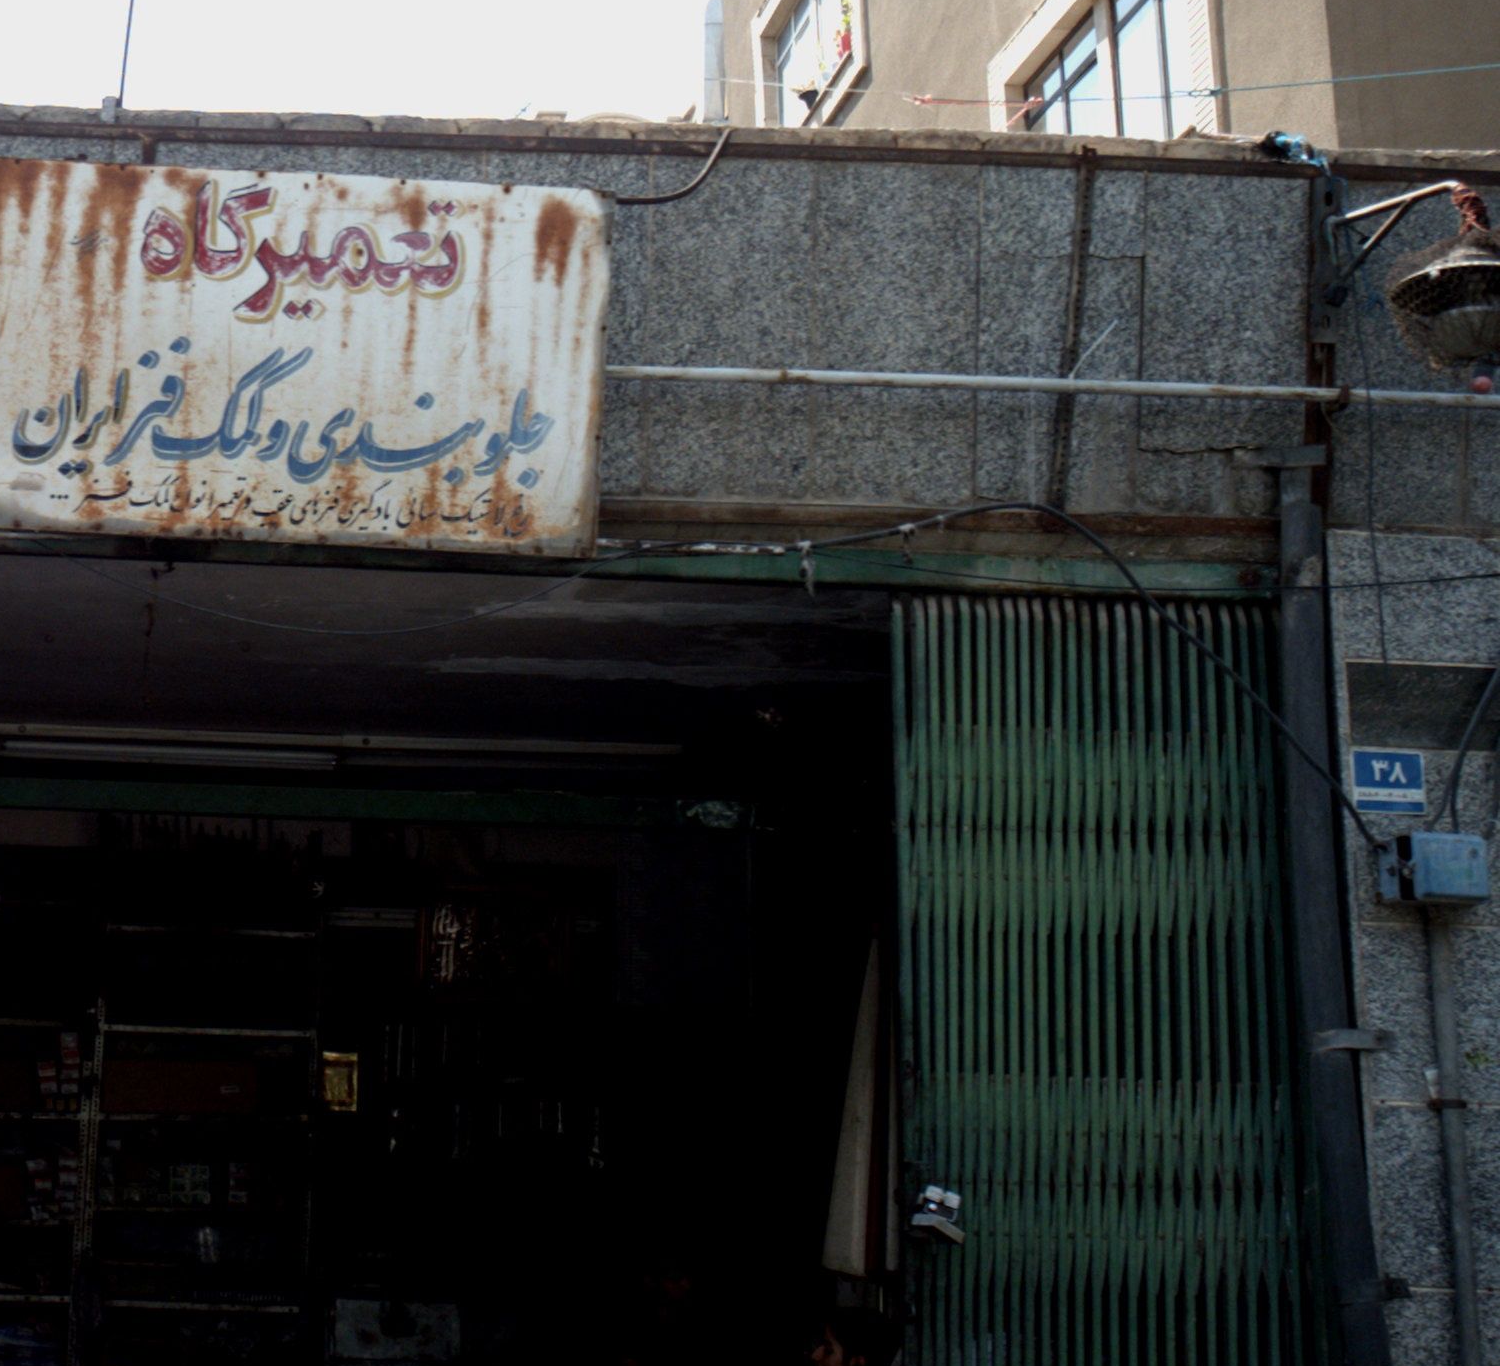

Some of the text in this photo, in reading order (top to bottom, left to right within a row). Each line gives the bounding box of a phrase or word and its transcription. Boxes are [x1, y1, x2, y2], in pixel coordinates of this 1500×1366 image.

[139, 181, 466, 323] تعمیرگاه
[12, 365, 129, 478] ایران
[104, 336, 191, 467] فنر
[152, 346, 312, 462] کمک
[259, 411, 285, 462] و
[73, 471, 133, 513] فنر
[129, 474, 180, 507] کمک
[169, 480, 215, 513] انواع
[206, 476, 248, 521] تعمیر
[252, 489, 294, 528] عقب
[1371, 760, 1408, 784] ۳۸
